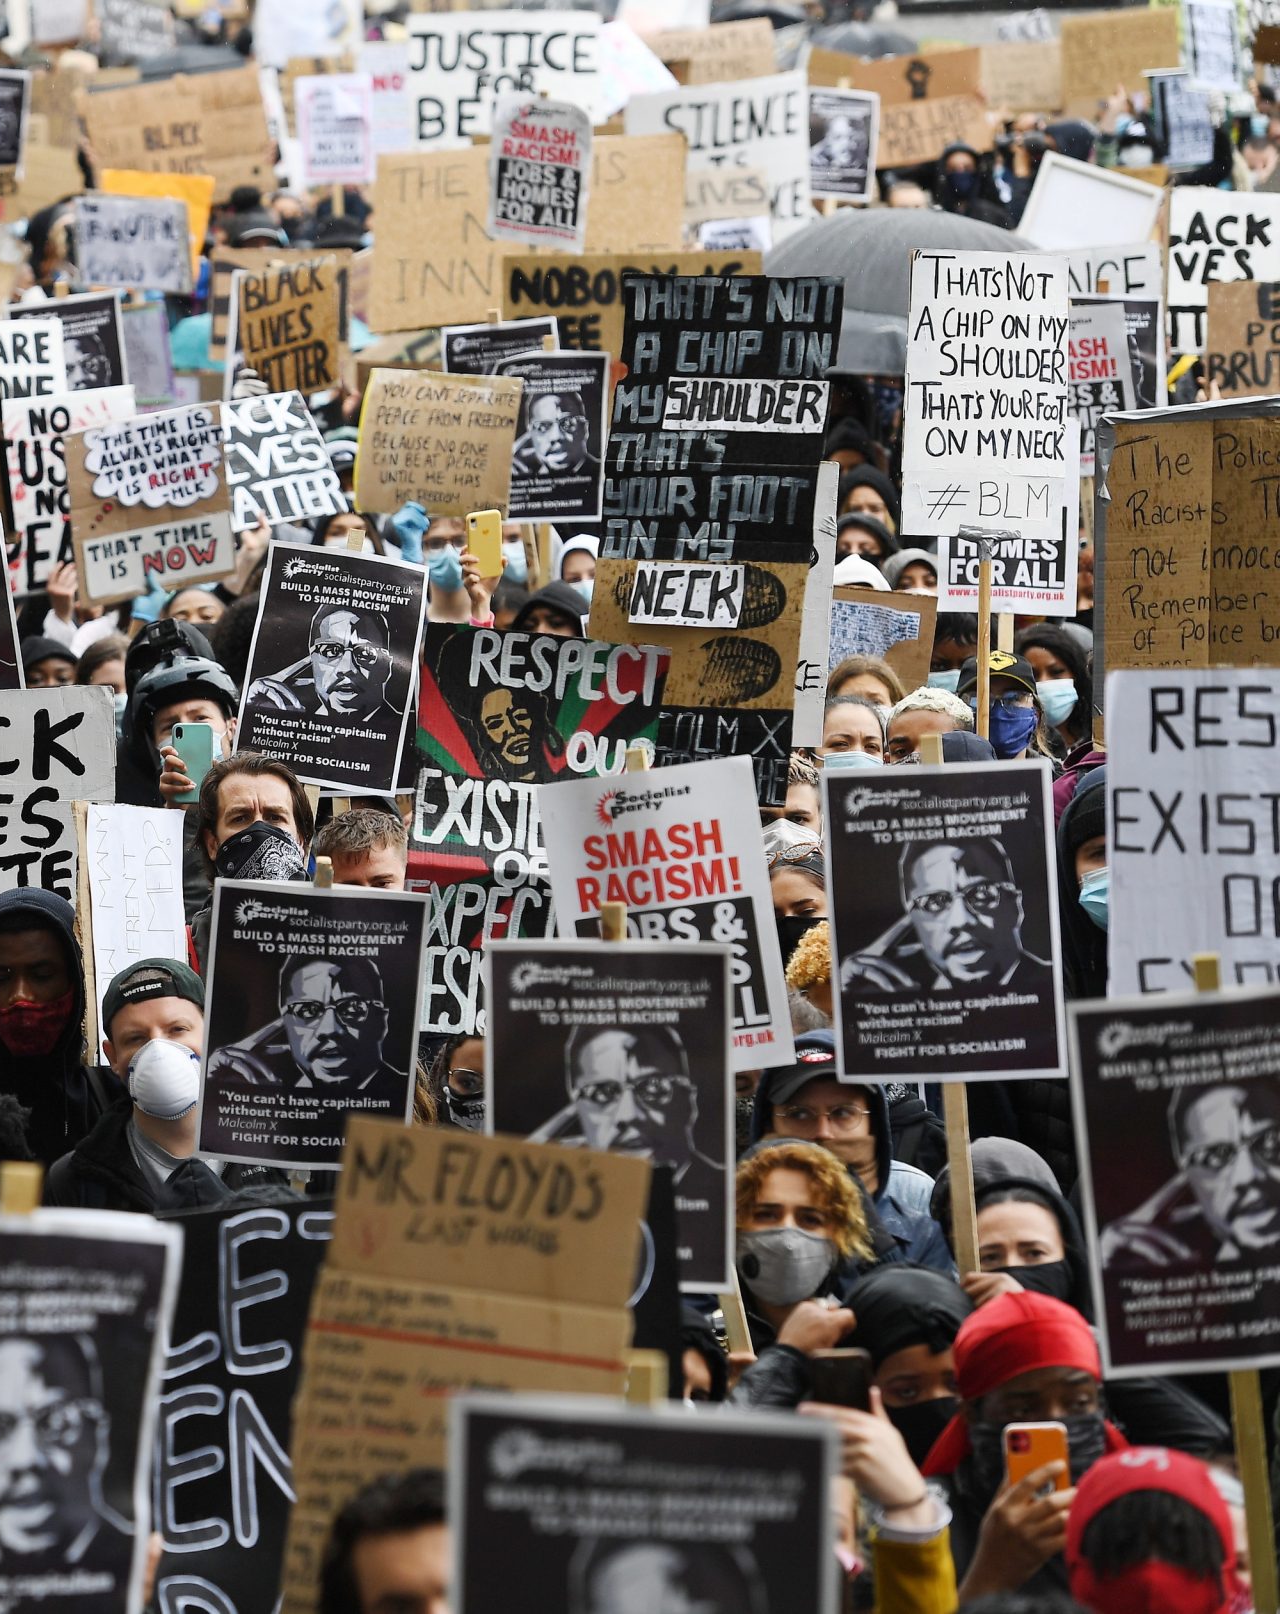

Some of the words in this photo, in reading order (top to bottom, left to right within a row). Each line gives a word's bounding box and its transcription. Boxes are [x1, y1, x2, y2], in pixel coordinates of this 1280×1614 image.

[409, 32, 598, 73] JUSTICE
[372, 74, 403, 91] NO
[476, 69, 536, 98] FOR
[509, 122, 576, 146] SMASH
[665, 90, 798, 149] SILENCE
[501, 139, 580, 166] RACISM!
[503, 160, 556, 184] JOBS
[500, 180, 575, 208] HOMES
[497, 200, 534, 222] FOR
[541, 207, 576, 229] ALL
[245, 263, 323, 302] BLACK
[1007, 262, 1053, 301] NOT
[625, 278, 752, 322] THAT'S
[766, 277, 844, 322] NOT
[246, 304, 314, 350] LIVES
[914, 306, 934, 341] A
[943, 308, 993, 339] CHIP
[1001, 315, 1029, 339] ON
[1039, 316, 1068, 344] MY
[633, 331, 660, 373] A
[676, 330, 763, 374] CHIP
[778, 331, 832, 378] ON
[377, 406, 418, 425] PEACE
[428, 410, 462, 425] FROM
[469, 411, 515, 428] FREEDOM
[614, 384, 663, 424] MY
[666, 379, 822, 426] SHOULDER
[911, 382, 982, 422] THAT'S
[990, 390, 1034, 420] YOUR
[1036, 393, 1067, 420] FOOT
[138, 421, 176, 441] TIME
[187, 413, 206, 429] IS
[926, 429, 967, 456] ON
[977, 431, 1012, 460] MY
[100, 441, 162, 469] ALWAYS
[168, 428, 225, 453] RIGHT
[105, 468, 122, 484] TO
[130, 462, 147, 478] DO
[153, 448, 202, 469] WHAT
[610, 432, 727, 471] THAT'S
[1114, 435, 1193, 480] The
[126, 481, 141, 496] IS
[380, 470, 414, 483] UNTIL
[426, 472, 445, 483] HE
[454, 474, 480, 487] HAS
[604, 476, 696, 518] YOUR
[709, 476, 809, 524] FOOT
[89, 535, 141, 557] THAT
[155, 521, 213, 546] TIME
[602, 519, 658, 559] ON
[674, 522, 736, 560] MY
[112, 558, 127, 579] IS
[142, 538, 217, 573] NOW
[1131, 546, 1178, 579] not
[281, 582, 311, 592] BUILD
[313, 585, 319, 593] A
[322, 586, 350, 596] MASS
[353, 589, 410, 605] MOVEMENT
[298, 560, 339, 573] Socialist
[324, 573, 413, 595] socialistparty.org.uk
[631, 569, 739, 621] NECK
[299, 594, 311, 602] TO
[314, 595, 348, 605] SMASH
[351, 600, 390, 612] RACISM
[1123, 586, 1268, 618] Remember
[1134, 630, 1156, 652] of
[1180, 620, 1243, 649] Police
[469, 630, 671, 707] RESPECT
[251, 736, 289, 749] Malcolm
[253, 727, 294, 738] without
[296, 732, 336, 743] racism"
[255, 714, 278, 724] "You
[281, 718, 306, 729] can't
[309, 722, 333, 732] have
[335, 725, 387, 740] capitalism
[294, 753, 313, 763] FOR
[316, 756, 370, 772] SOCIALISM
[616, 785, 691, 802] Socialist
[583, 819, 722, 871] SMASH
[576, 857, 743, 912] RACISM!
[433, 1141, 606, 1221] FLOYD'S
